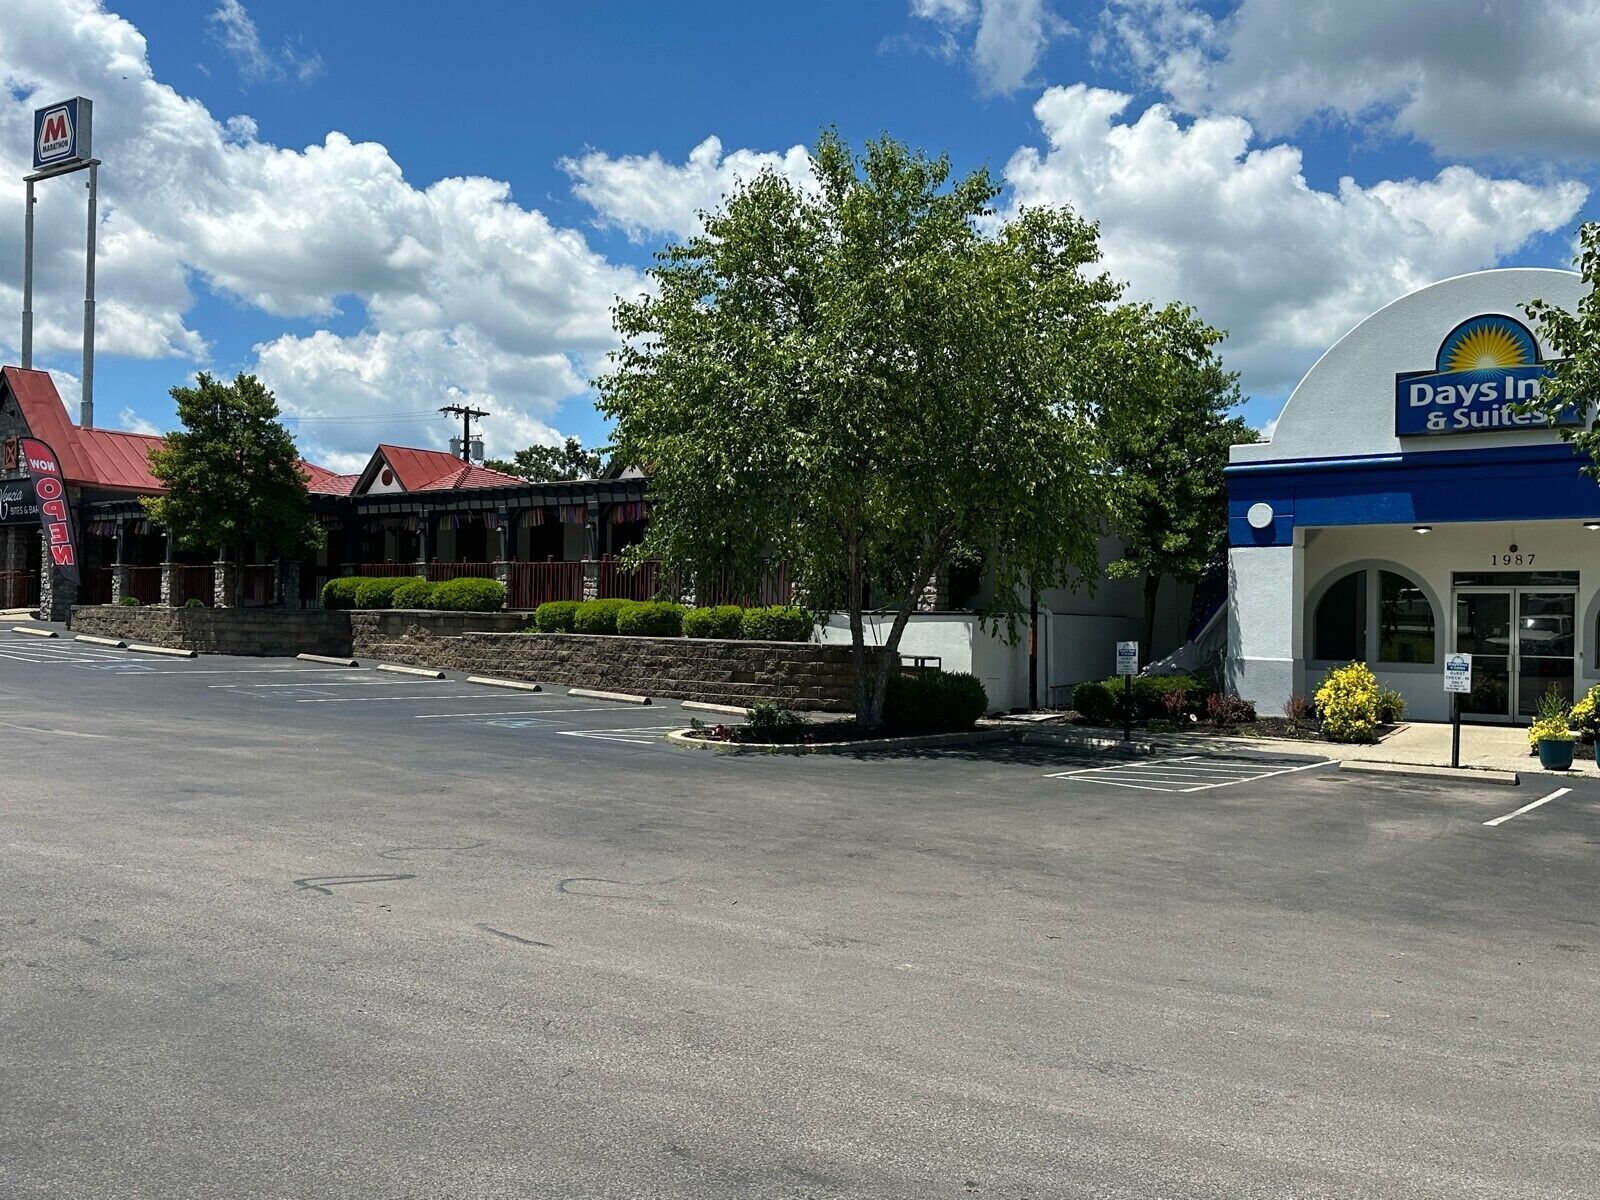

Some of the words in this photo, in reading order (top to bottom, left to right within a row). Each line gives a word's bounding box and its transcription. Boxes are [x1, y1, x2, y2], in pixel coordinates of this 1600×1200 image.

[43, 115, 67, 143] M
[42, 139, 69, 153] MARATHON
[1410, 381, 1498, 407] Days
[1505, 376, 1546, 400] In
[1426, 411, 1447, 431] &
[1453, 403, 1548, 429] Suites
[10, 506, 23, 515] BITES
[1492, 554, 1536, 566] 1987
